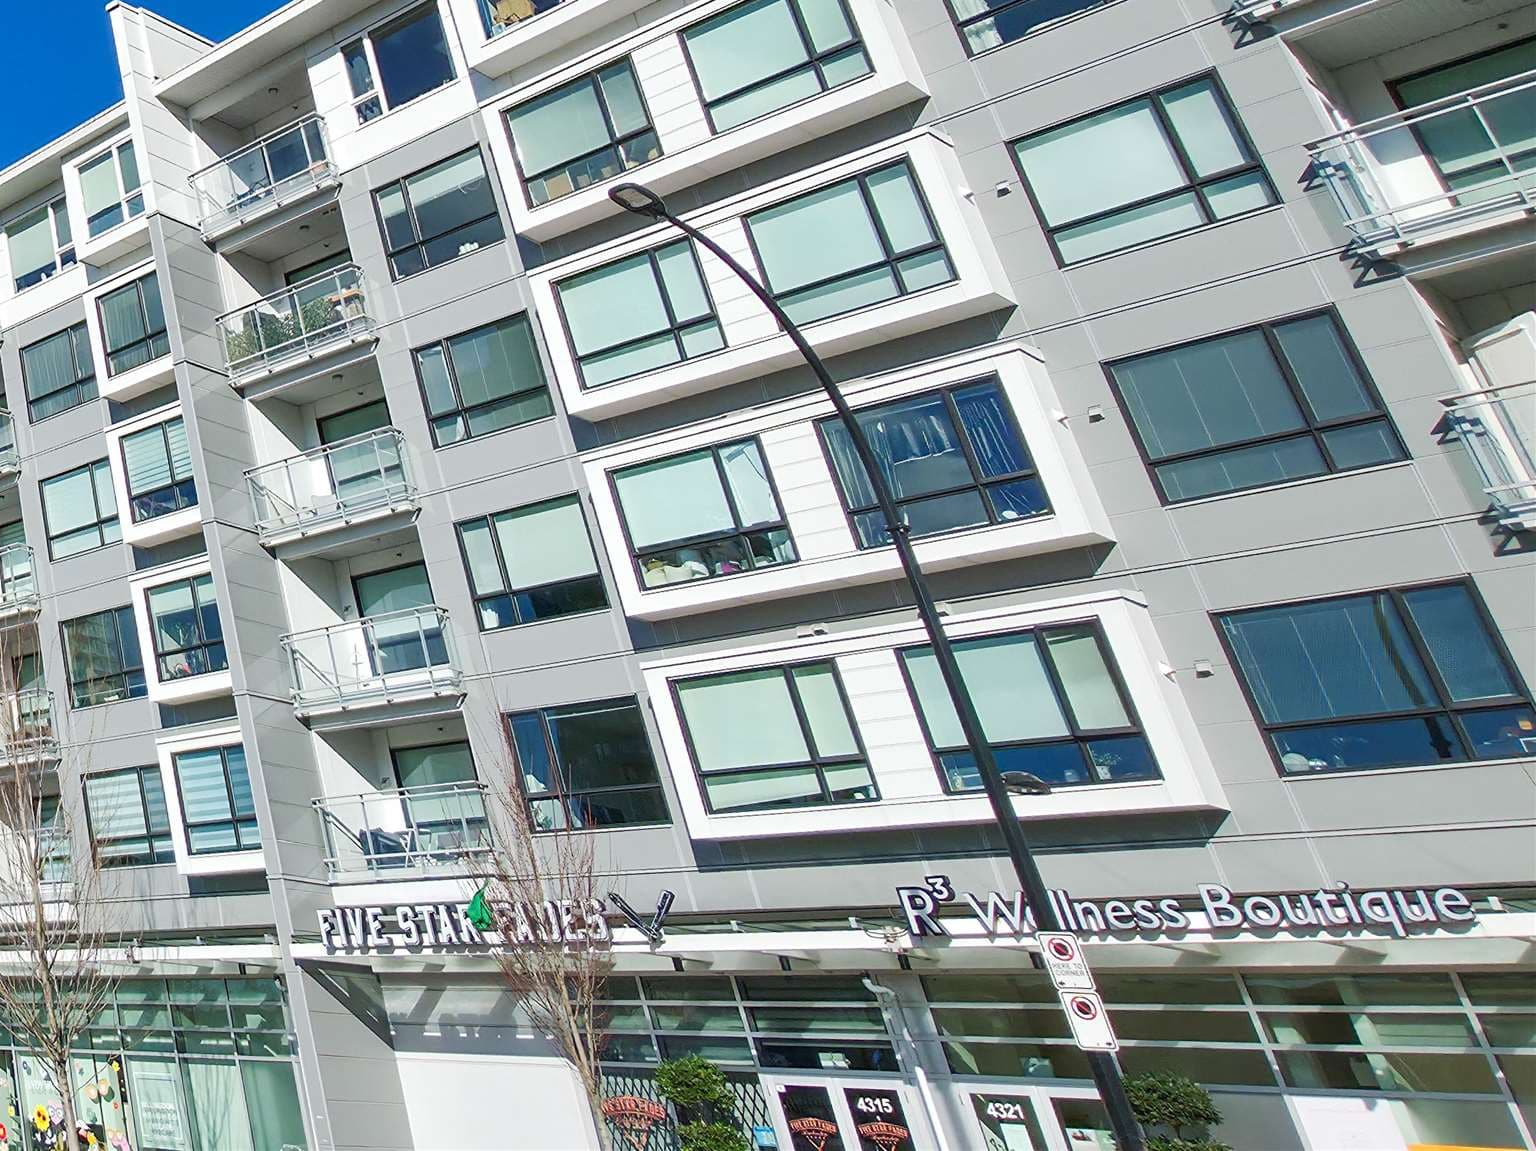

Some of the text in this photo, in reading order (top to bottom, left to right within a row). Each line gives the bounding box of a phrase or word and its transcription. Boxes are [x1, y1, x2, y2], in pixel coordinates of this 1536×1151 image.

[964, 889, 1189, 932] Wllness
[1198, 881, 1475, 938] Boutique
[317, 906, 388, 948] FIVE
[857, 1097, 893, 1113] 4315
[987, 1102, 1024, 1119] 4321
